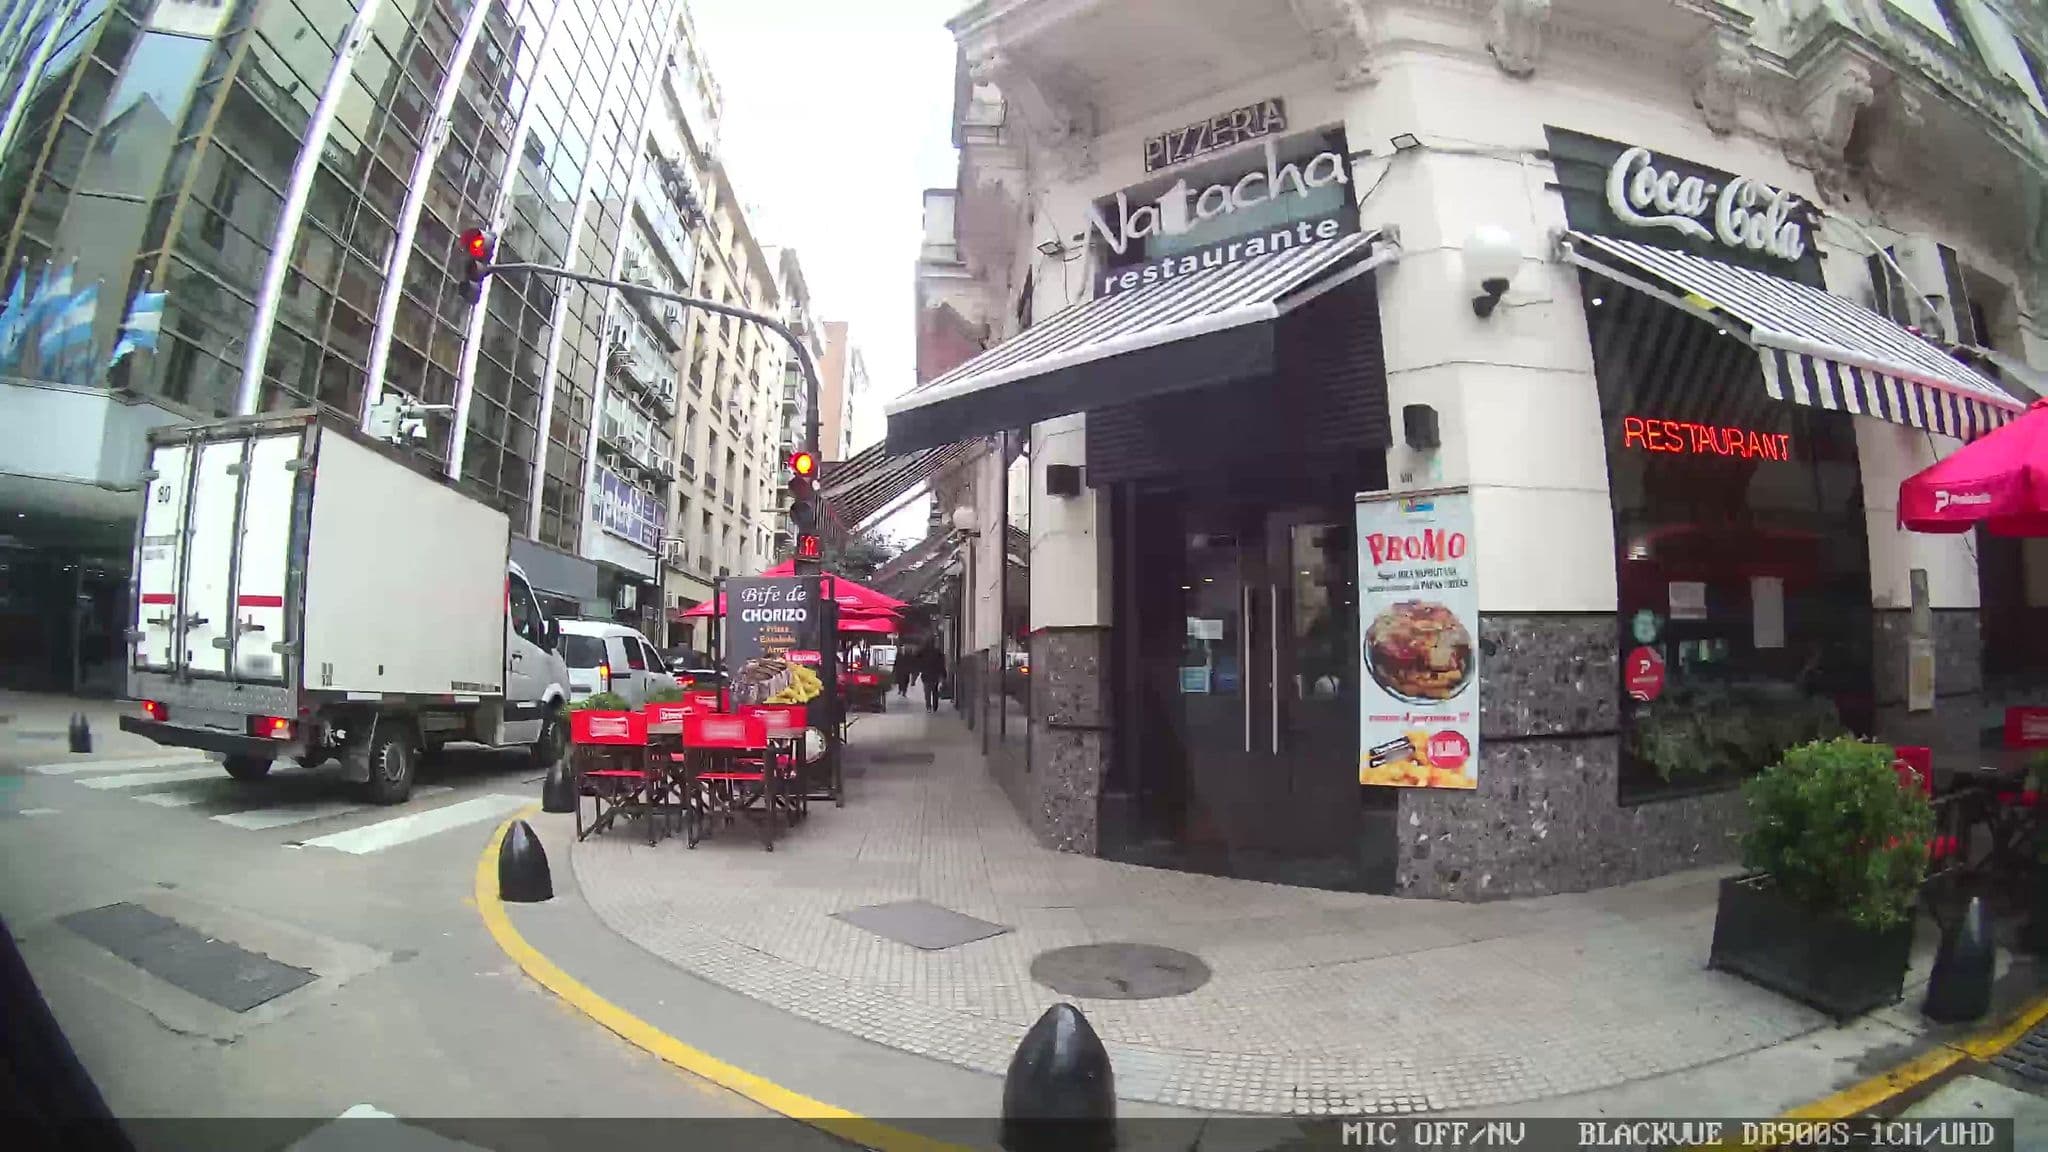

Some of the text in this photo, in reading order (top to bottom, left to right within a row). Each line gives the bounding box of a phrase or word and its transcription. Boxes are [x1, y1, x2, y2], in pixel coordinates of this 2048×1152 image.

[1144, 97, 1286, 171] PIZZERIA
[1086, 137, 1348, 255] Natacha
[1606, 146, 1806, 263] Coca-Cola
[1104, 215, 1341, 294] restaurante
[1623, 416, 1791, 462] RESTAURANT
[1366, 528, 1466, 566] PROMO
[741, 585, 807, 607] Bife de
[741, 608, 807, 622] CHORIZO
